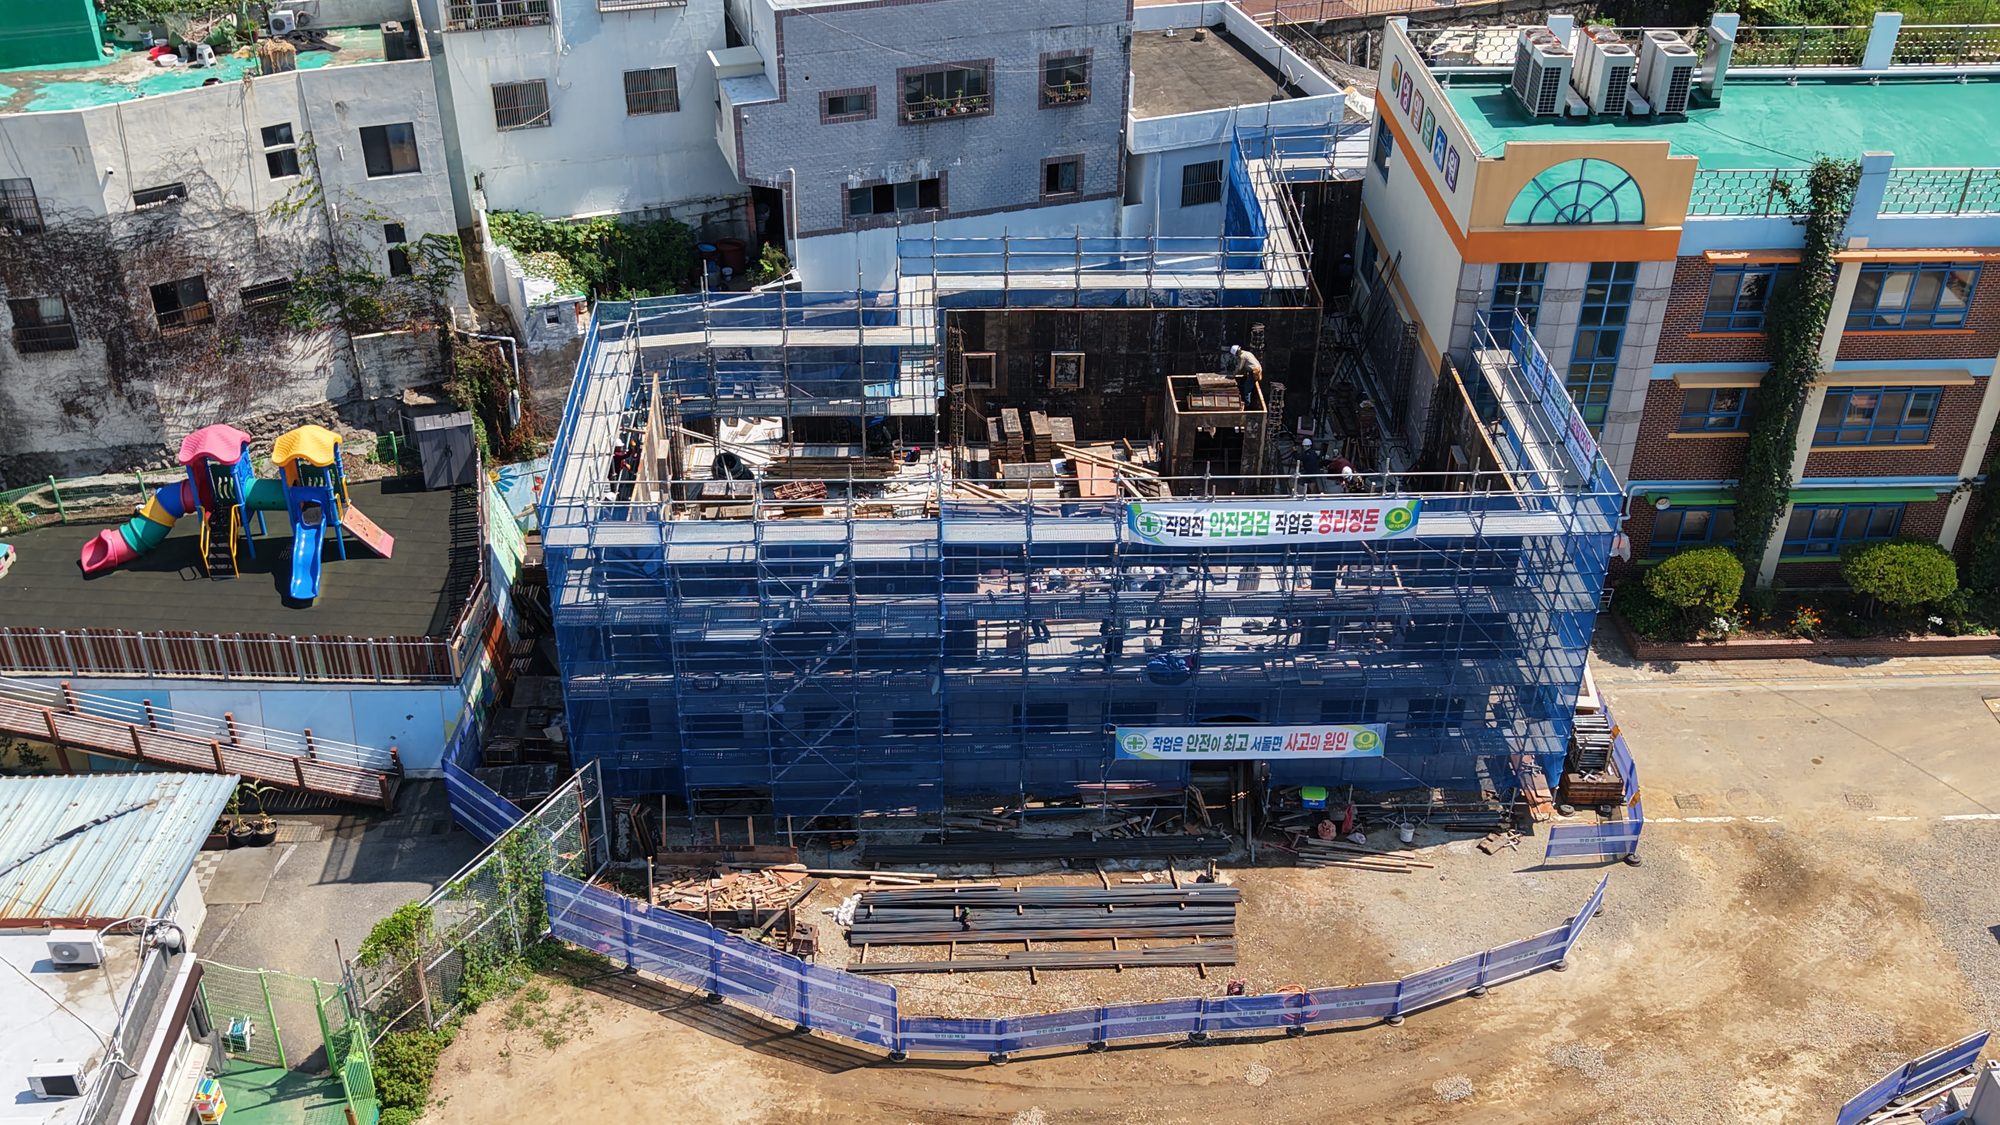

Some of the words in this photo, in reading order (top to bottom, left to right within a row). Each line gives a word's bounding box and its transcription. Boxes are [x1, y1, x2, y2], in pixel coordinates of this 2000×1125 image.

[1166, 516, 1204, 537] 작업전
[1275, 513, 1313, 535] 작업후
[1318, 509, 1379, 534] 정리정돈
[1153, 736, 1183, 752] 작업은
[1186, 734, 1221, 752] 안전이
[1223, 733, 1249, 752] 최고
[1284, 733, 1321, 751] 사고의
[1323, 732, 1349, 751] 원인
